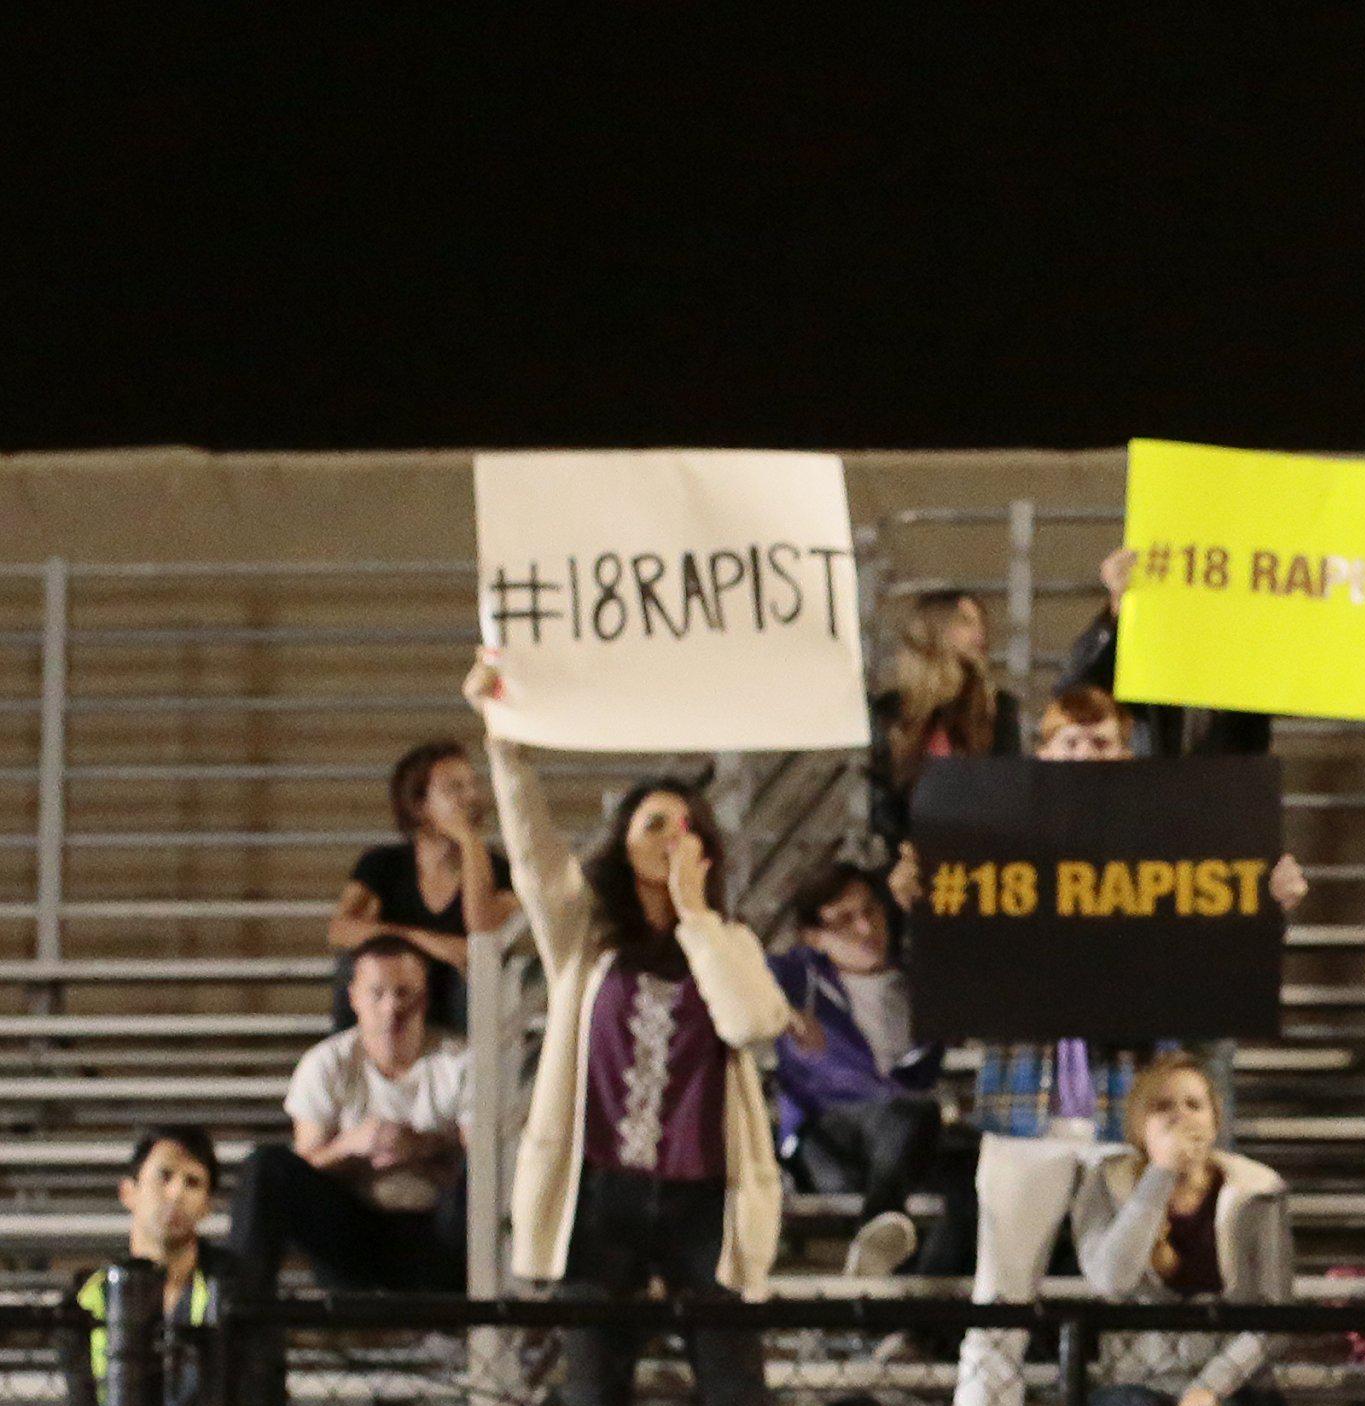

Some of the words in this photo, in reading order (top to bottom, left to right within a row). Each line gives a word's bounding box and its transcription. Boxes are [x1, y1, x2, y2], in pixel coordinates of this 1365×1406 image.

[1145, 541, 1230, 591] #18
[930, 861, 1038, 919] #18
[1056, 857, 1266, 918] RAPIST
